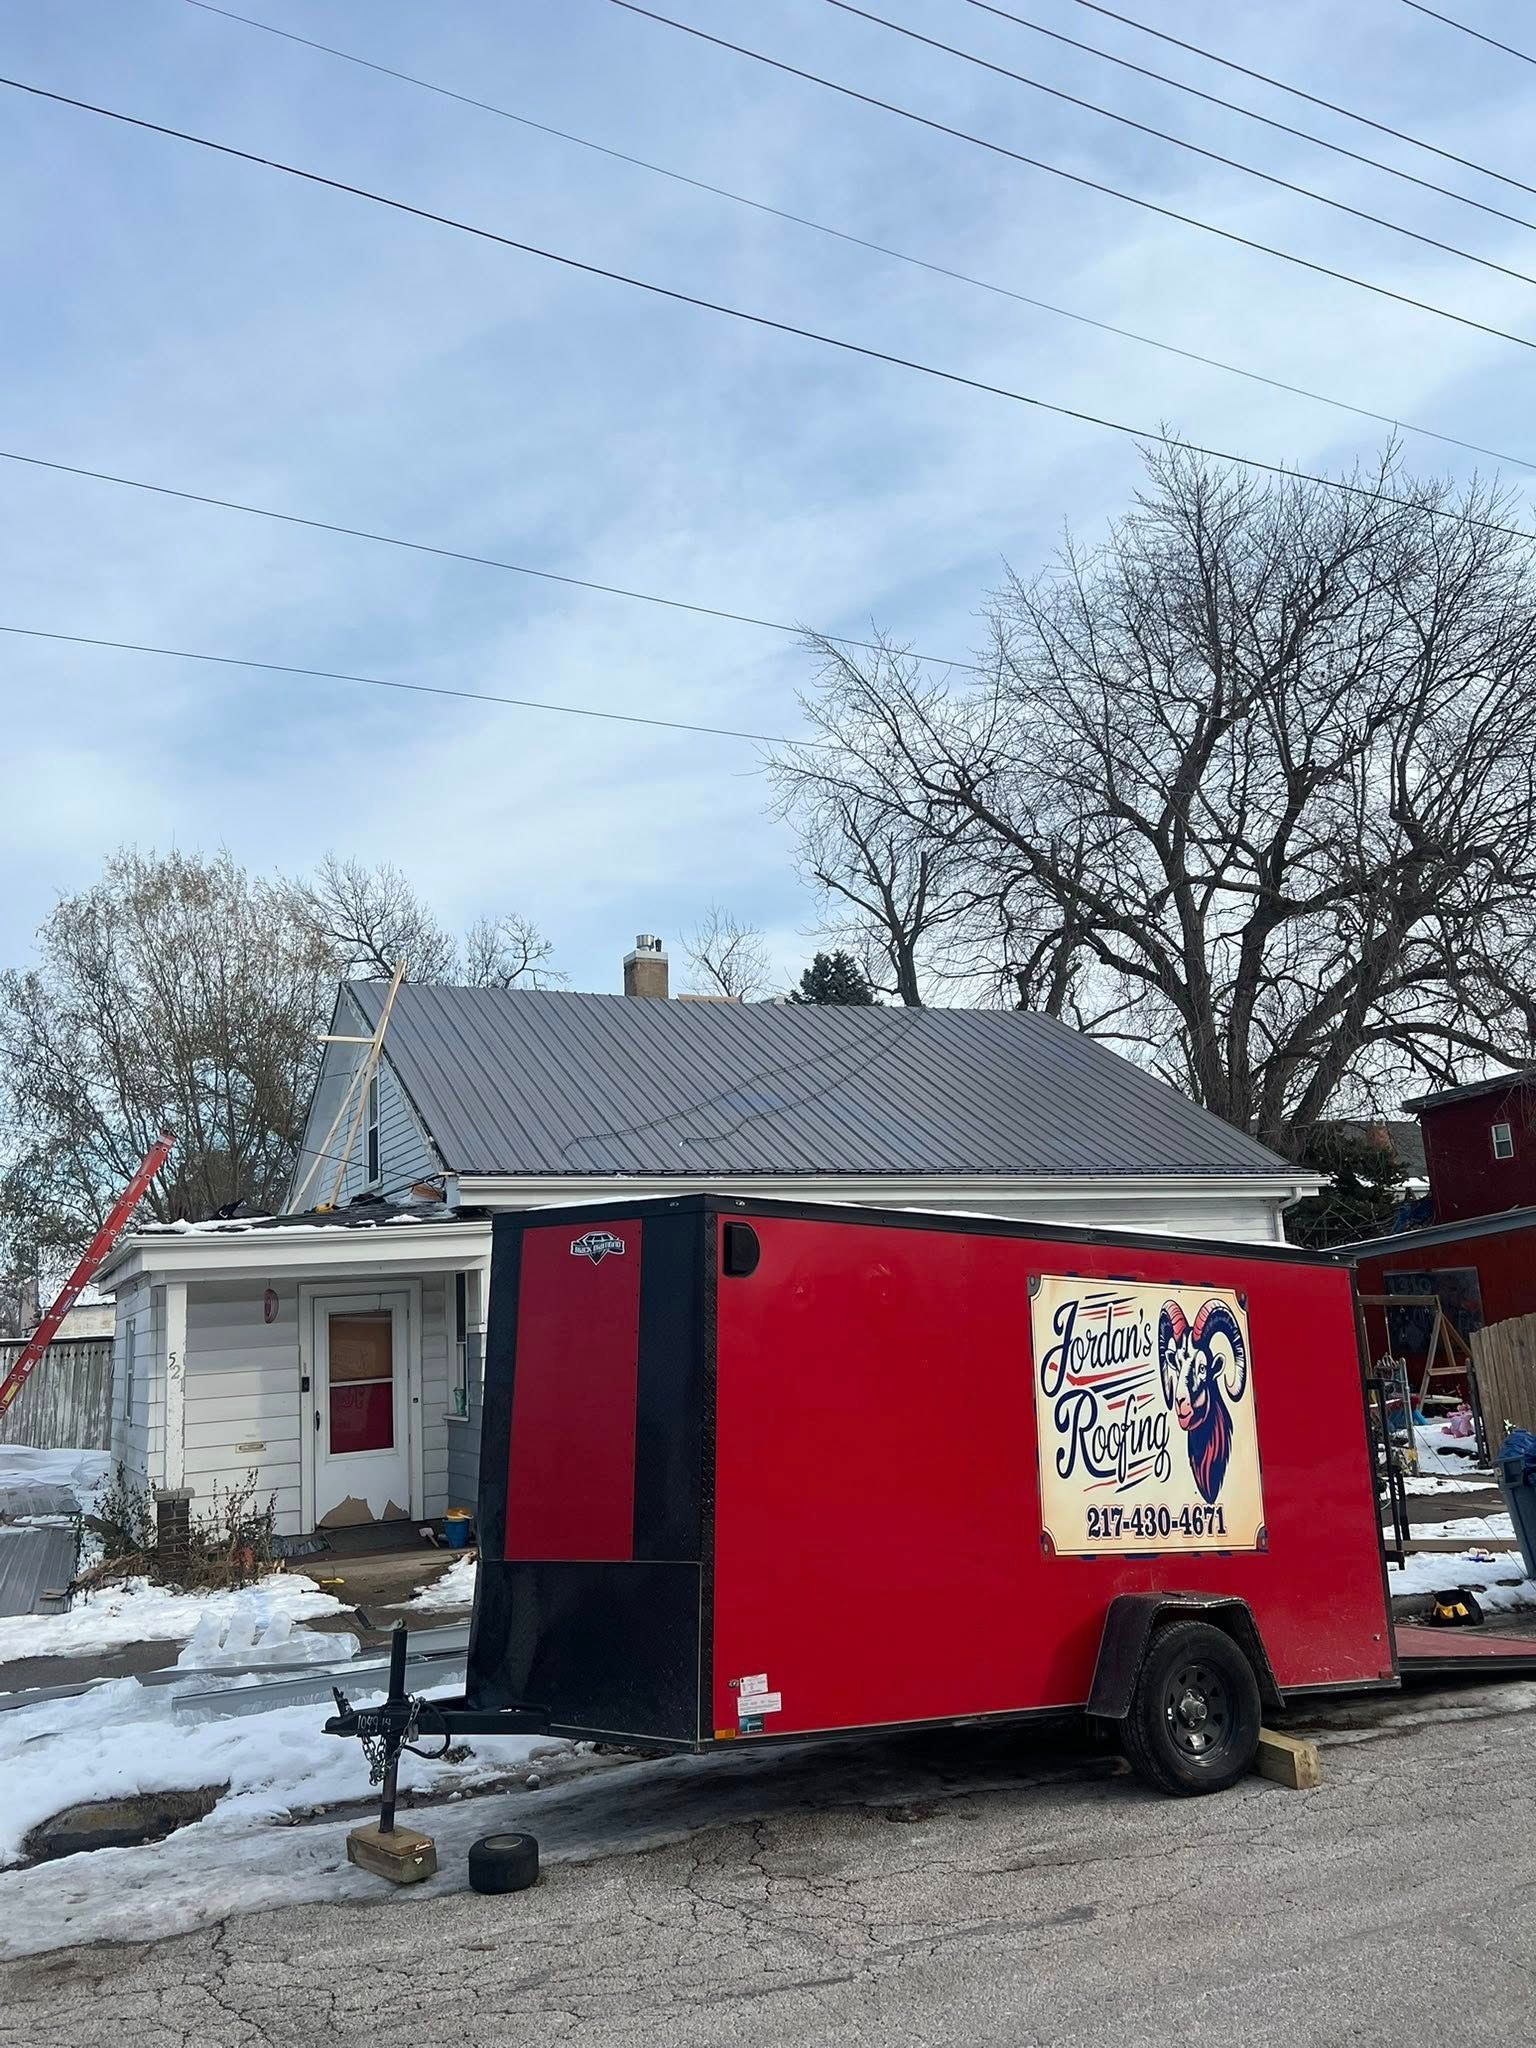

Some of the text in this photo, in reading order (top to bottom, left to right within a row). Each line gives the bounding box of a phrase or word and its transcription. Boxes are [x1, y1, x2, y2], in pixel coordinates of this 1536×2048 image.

[1041, 1301, 1153, 1397] Jordan's
[1055, 1389, 1171, 1483] Roofing
[1087, 1504, 1227, 1540] 217-430-4671
